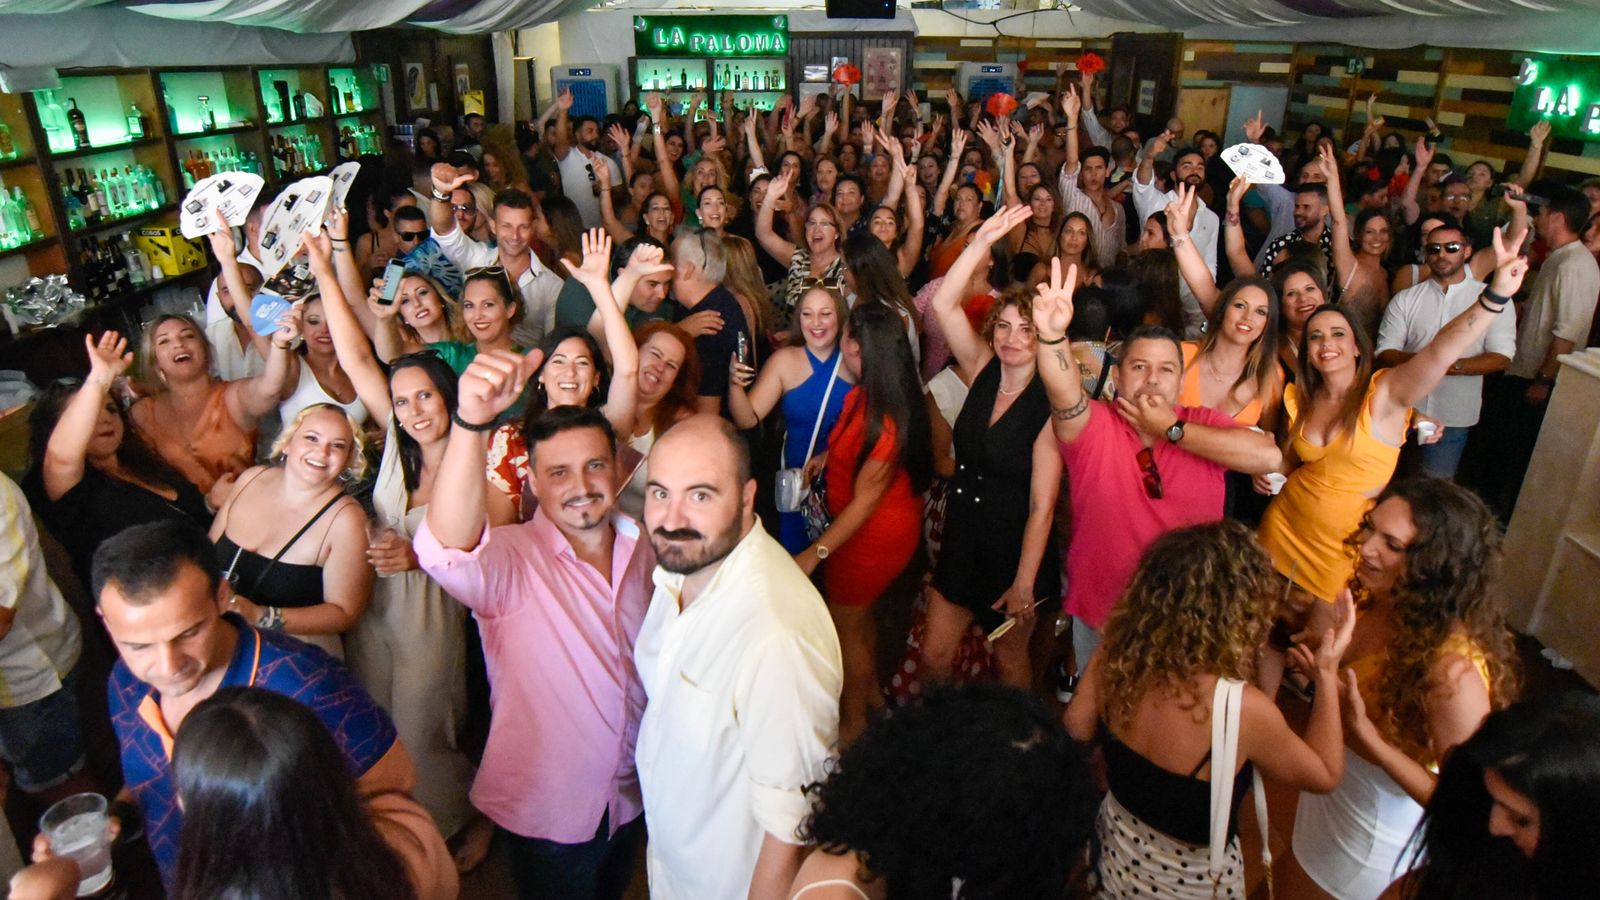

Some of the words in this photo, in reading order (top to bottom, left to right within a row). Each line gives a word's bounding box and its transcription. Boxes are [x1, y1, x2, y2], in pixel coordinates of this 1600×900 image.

[654, 27, 685, 46] LA
[690, 33, 785, 52] PALOMA
[1532, 86, 1580, 116] LA
